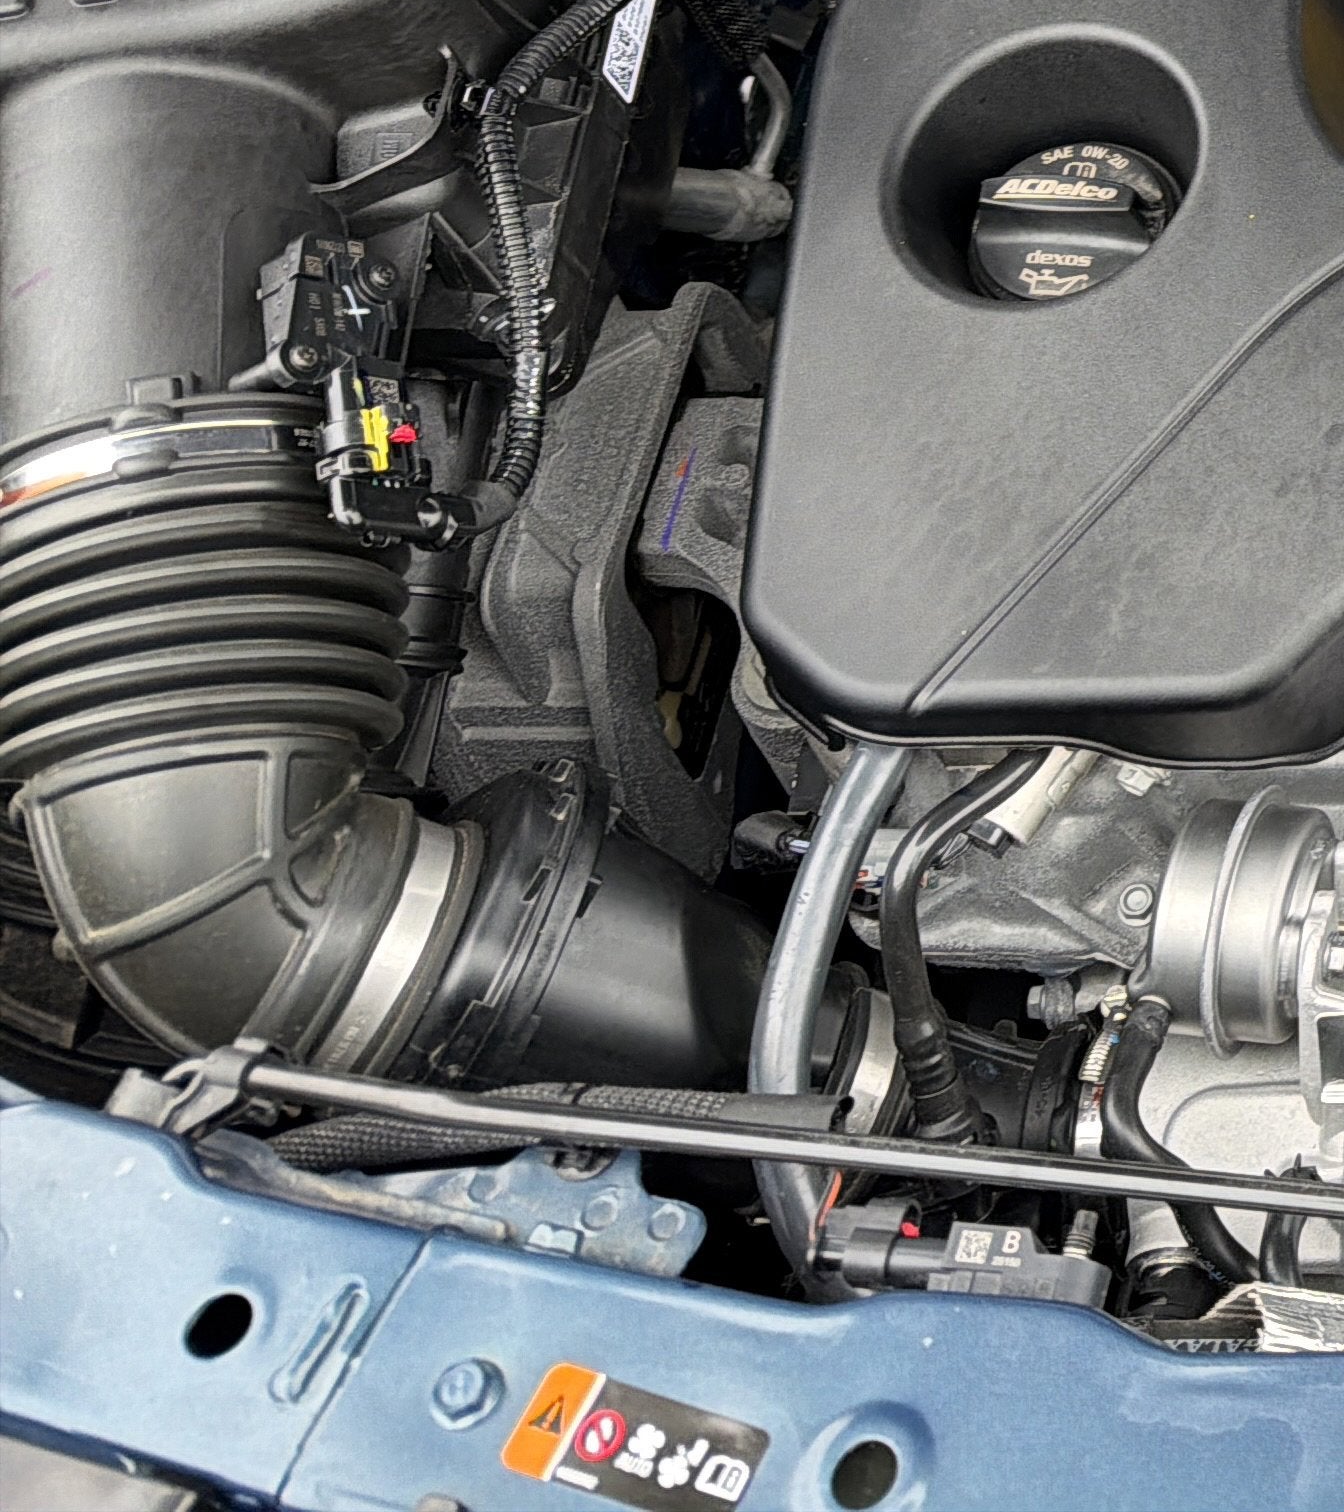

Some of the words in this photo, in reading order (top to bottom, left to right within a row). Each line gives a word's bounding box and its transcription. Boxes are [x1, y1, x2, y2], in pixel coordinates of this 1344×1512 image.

[1041, 145, 1074, 165] SAE
[1081, 145, 1130, 170] 0W-20
[996, 178, 1119, 201] ACDelco
[1026, 250, 1095, 267] dexos
[1001, 1230, 1022, 1254] B
[613, 1451, 655, 1479] AUTO
